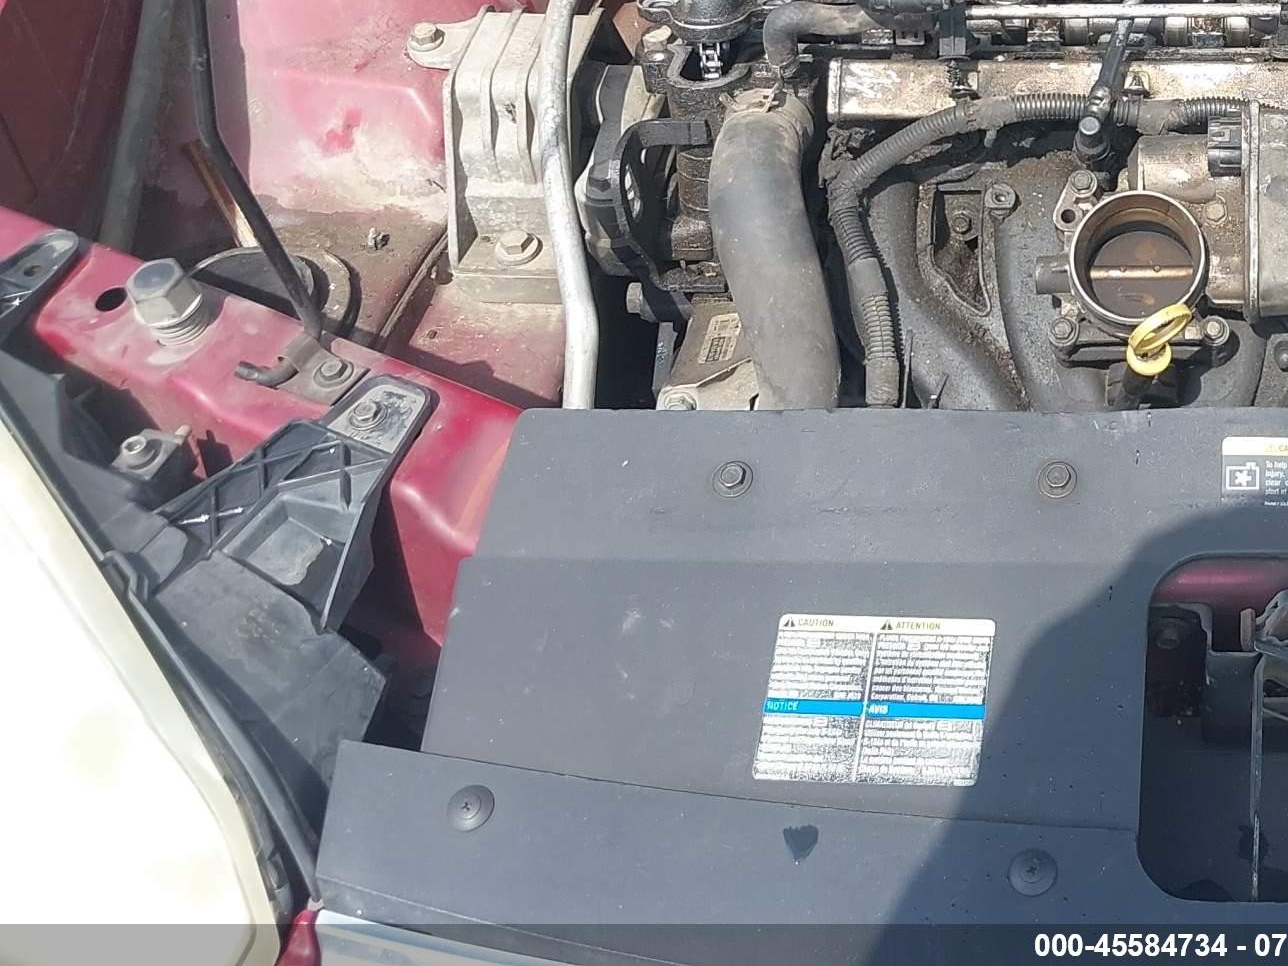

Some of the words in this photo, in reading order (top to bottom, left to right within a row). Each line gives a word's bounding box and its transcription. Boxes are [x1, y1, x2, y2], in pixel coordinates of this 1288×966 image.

[1265, 460, 1273, 468] To
[1274, 461, 1288, 470] help
[1265, 479, 1281, 487] clear
[797, 619, 834, 627] CAUTION
[895, 621, 941, 630] ATTENTION
[766, 701, 799, 711] NOTICE
